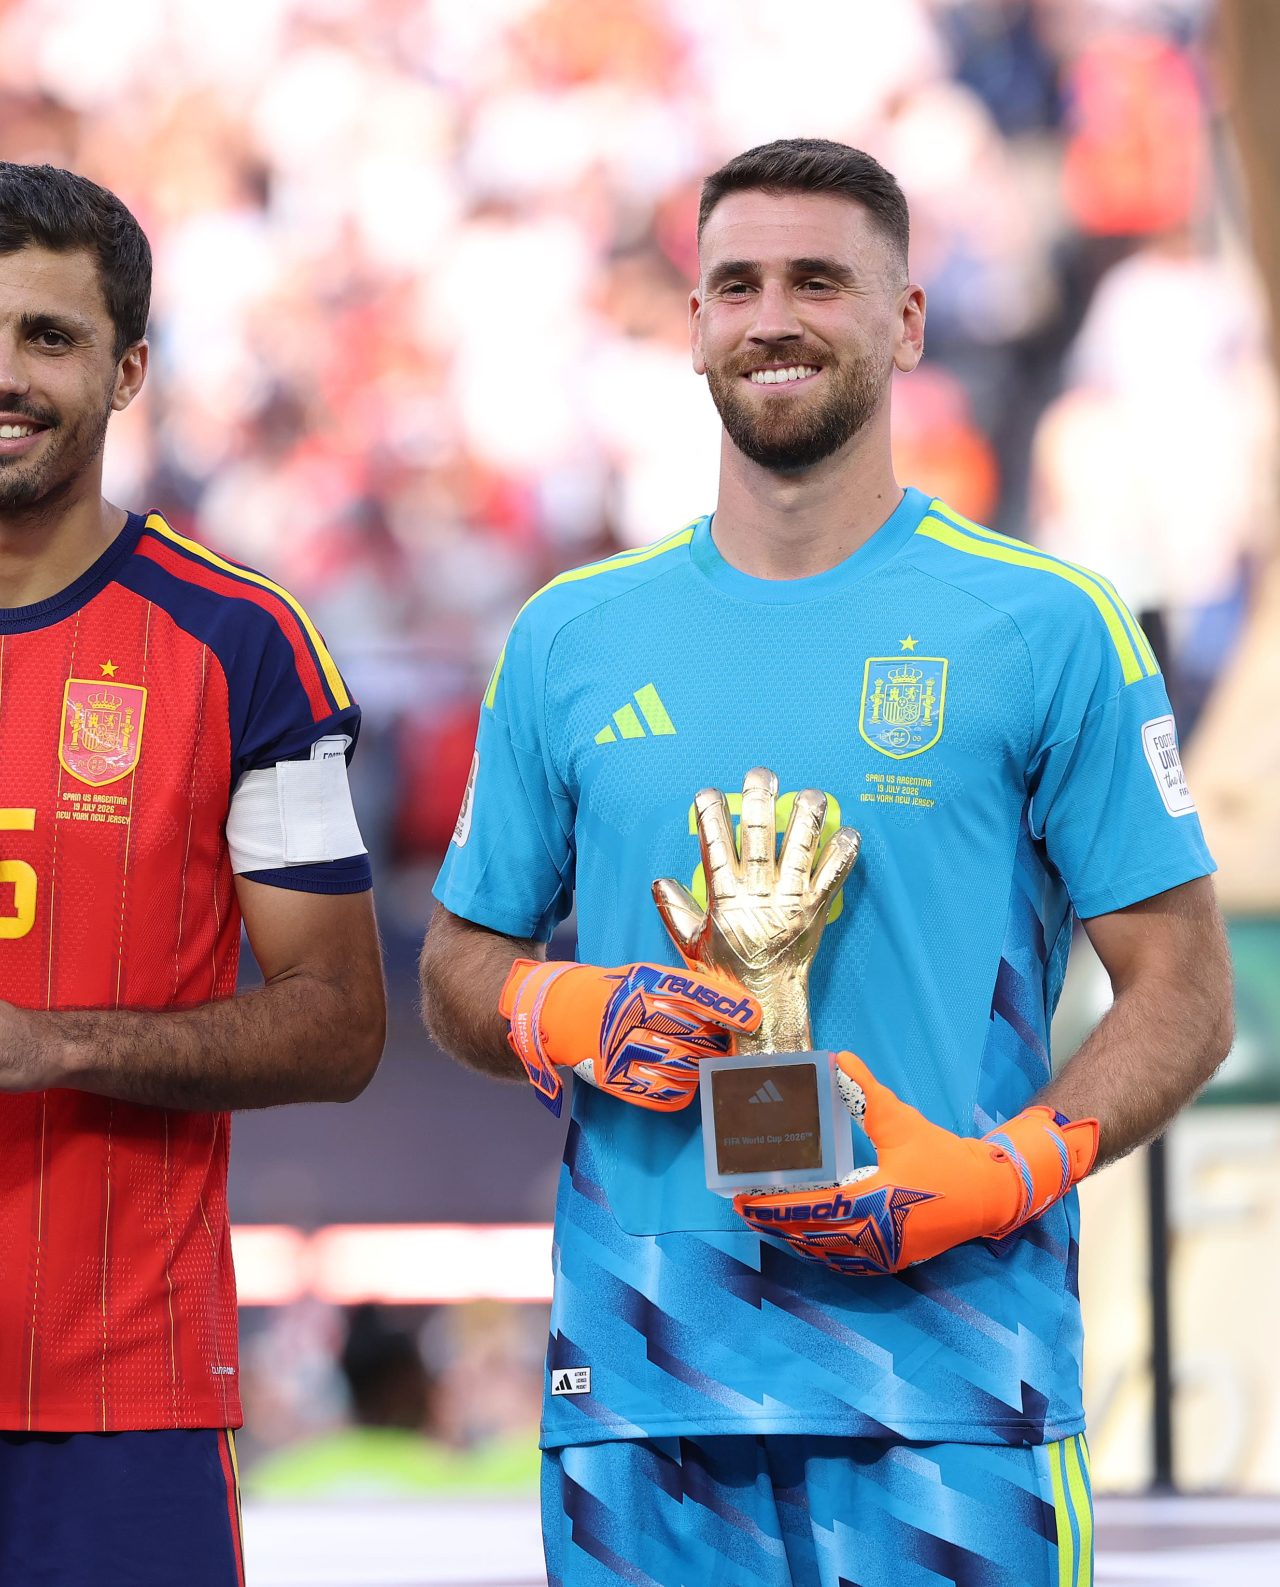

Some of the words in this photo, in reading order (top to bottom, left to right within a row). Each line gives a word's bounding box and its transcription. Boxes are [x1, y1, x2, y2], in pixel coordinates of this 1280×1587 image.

[866, 774, 884, 782] SPAIN
[897, 776, 931, 787] ARGENTINA
[877, 784, 883, 792] 19
[886, 785, 900, 793] JULY
[902, 786, 919, 795] 2026
[63, 793, 81, 801] SPAIN
[93, 794, 127, 805] ARGENTINA
[861, 794, 875, 802] NEW
[877, 794, 893, 803] YORK
[895, 796, 910, 804] NEW
[912, 798, 934, 807] JERSEY
[73, 802, 80, 810] 19
[82, 803, 96, 811] JULY
[97, 805, 114, 813] 2026
[56, 811, 71, 819] NEW
[72, 812, 89, 820] YORK
[91, 814, 105, 822] NEW
[107, 815, 130, 824] JERSEY
[657, 973, 754, 1024] reusch
[723, 1137, 740, 1146] FIFA
[741, 1135, 765, 1145] World
[766, 1135, 782, 1145] Cup
[743, 1194, 851, 1221] reusch
